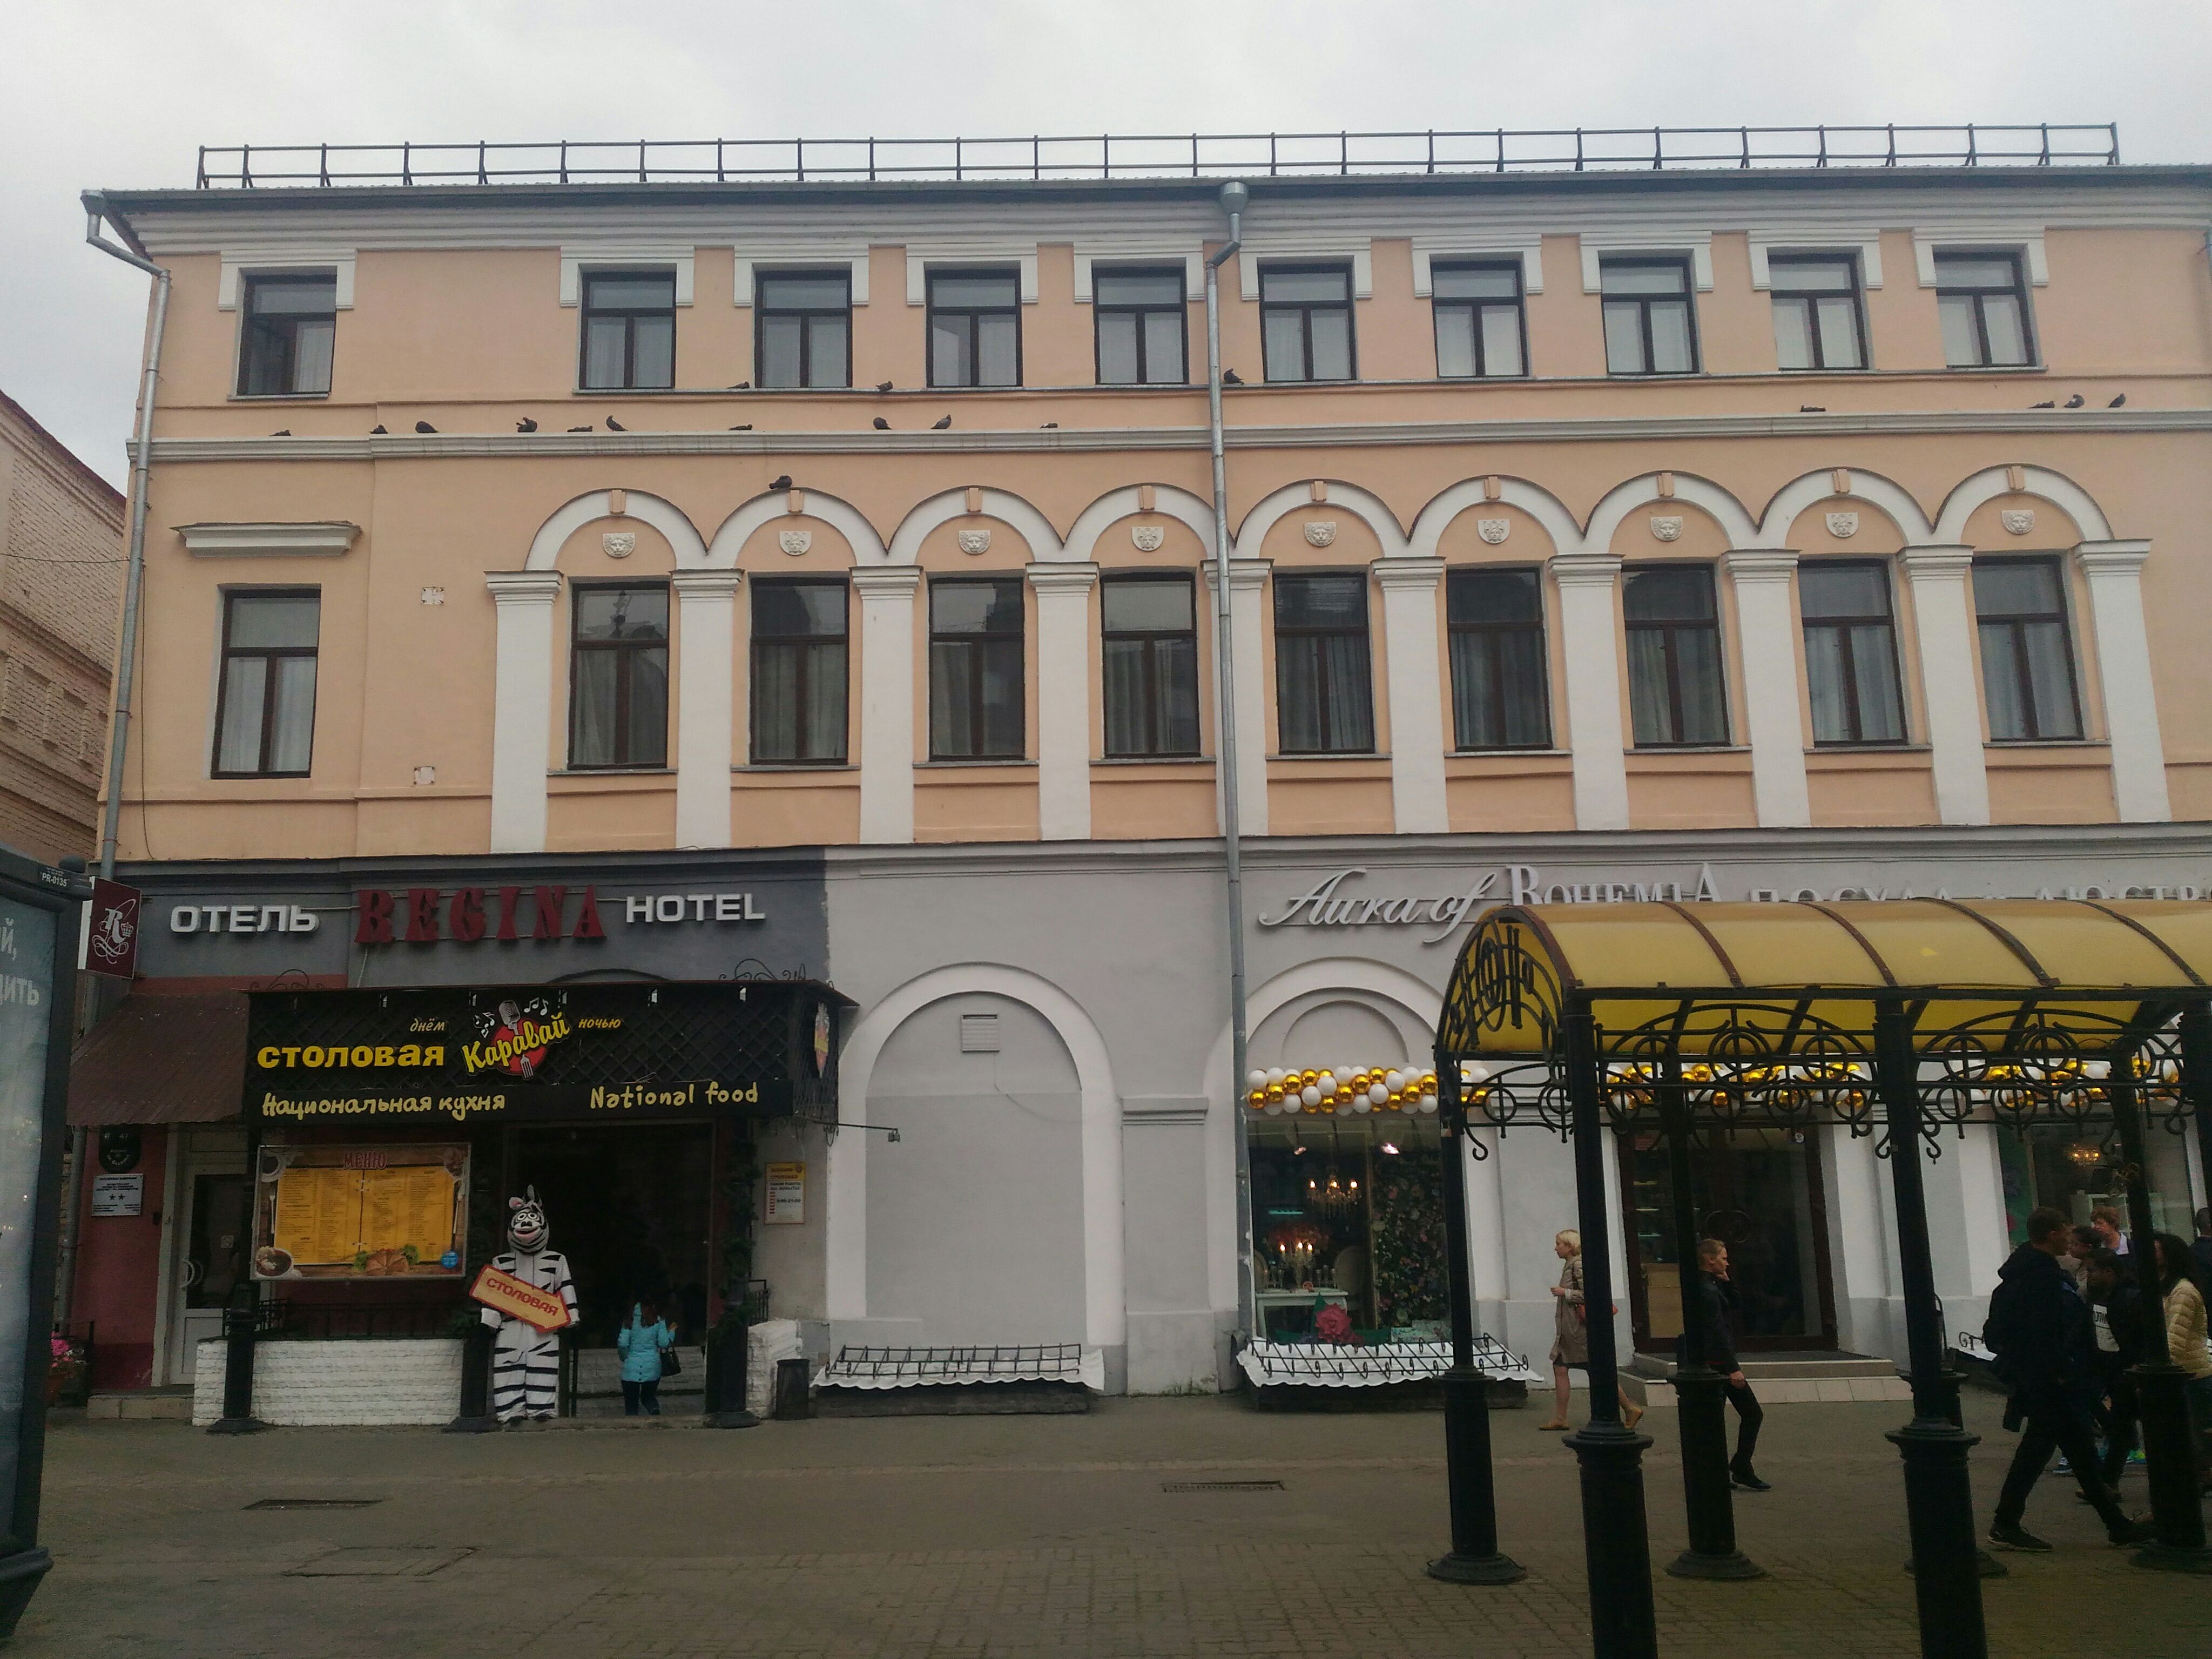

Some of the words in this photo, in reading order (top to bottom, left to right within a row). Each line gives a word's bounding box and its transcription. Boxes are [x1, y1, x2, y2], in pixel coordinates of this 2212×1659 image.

[170, 904, 320, 933] ОТЕЛЬ
[354, 885, 607, 943] REGINA
[626, 893, 766, 923] HOTEL
[1259, 867, 1422, 927] Aura
[1422, 872, 1497, 945] of
[409, 1017, 446, 1032] днём
[578, 1017, 622, 1029] ночью
[257, 1044, 444, 1069] столовая
[461, 1011, 571, 1074] Каравай
[261, 1091, 432, 1121] Национальная
[438, 1094, 506, 1122] кухня
[590, 1084, 695, 1110] National
[705, 1081, 758, 1104] food
[343, 1151, 387, 1169] МЕНЮ
[486, 1277, 559, 1317] СТОЛОВАЯ
